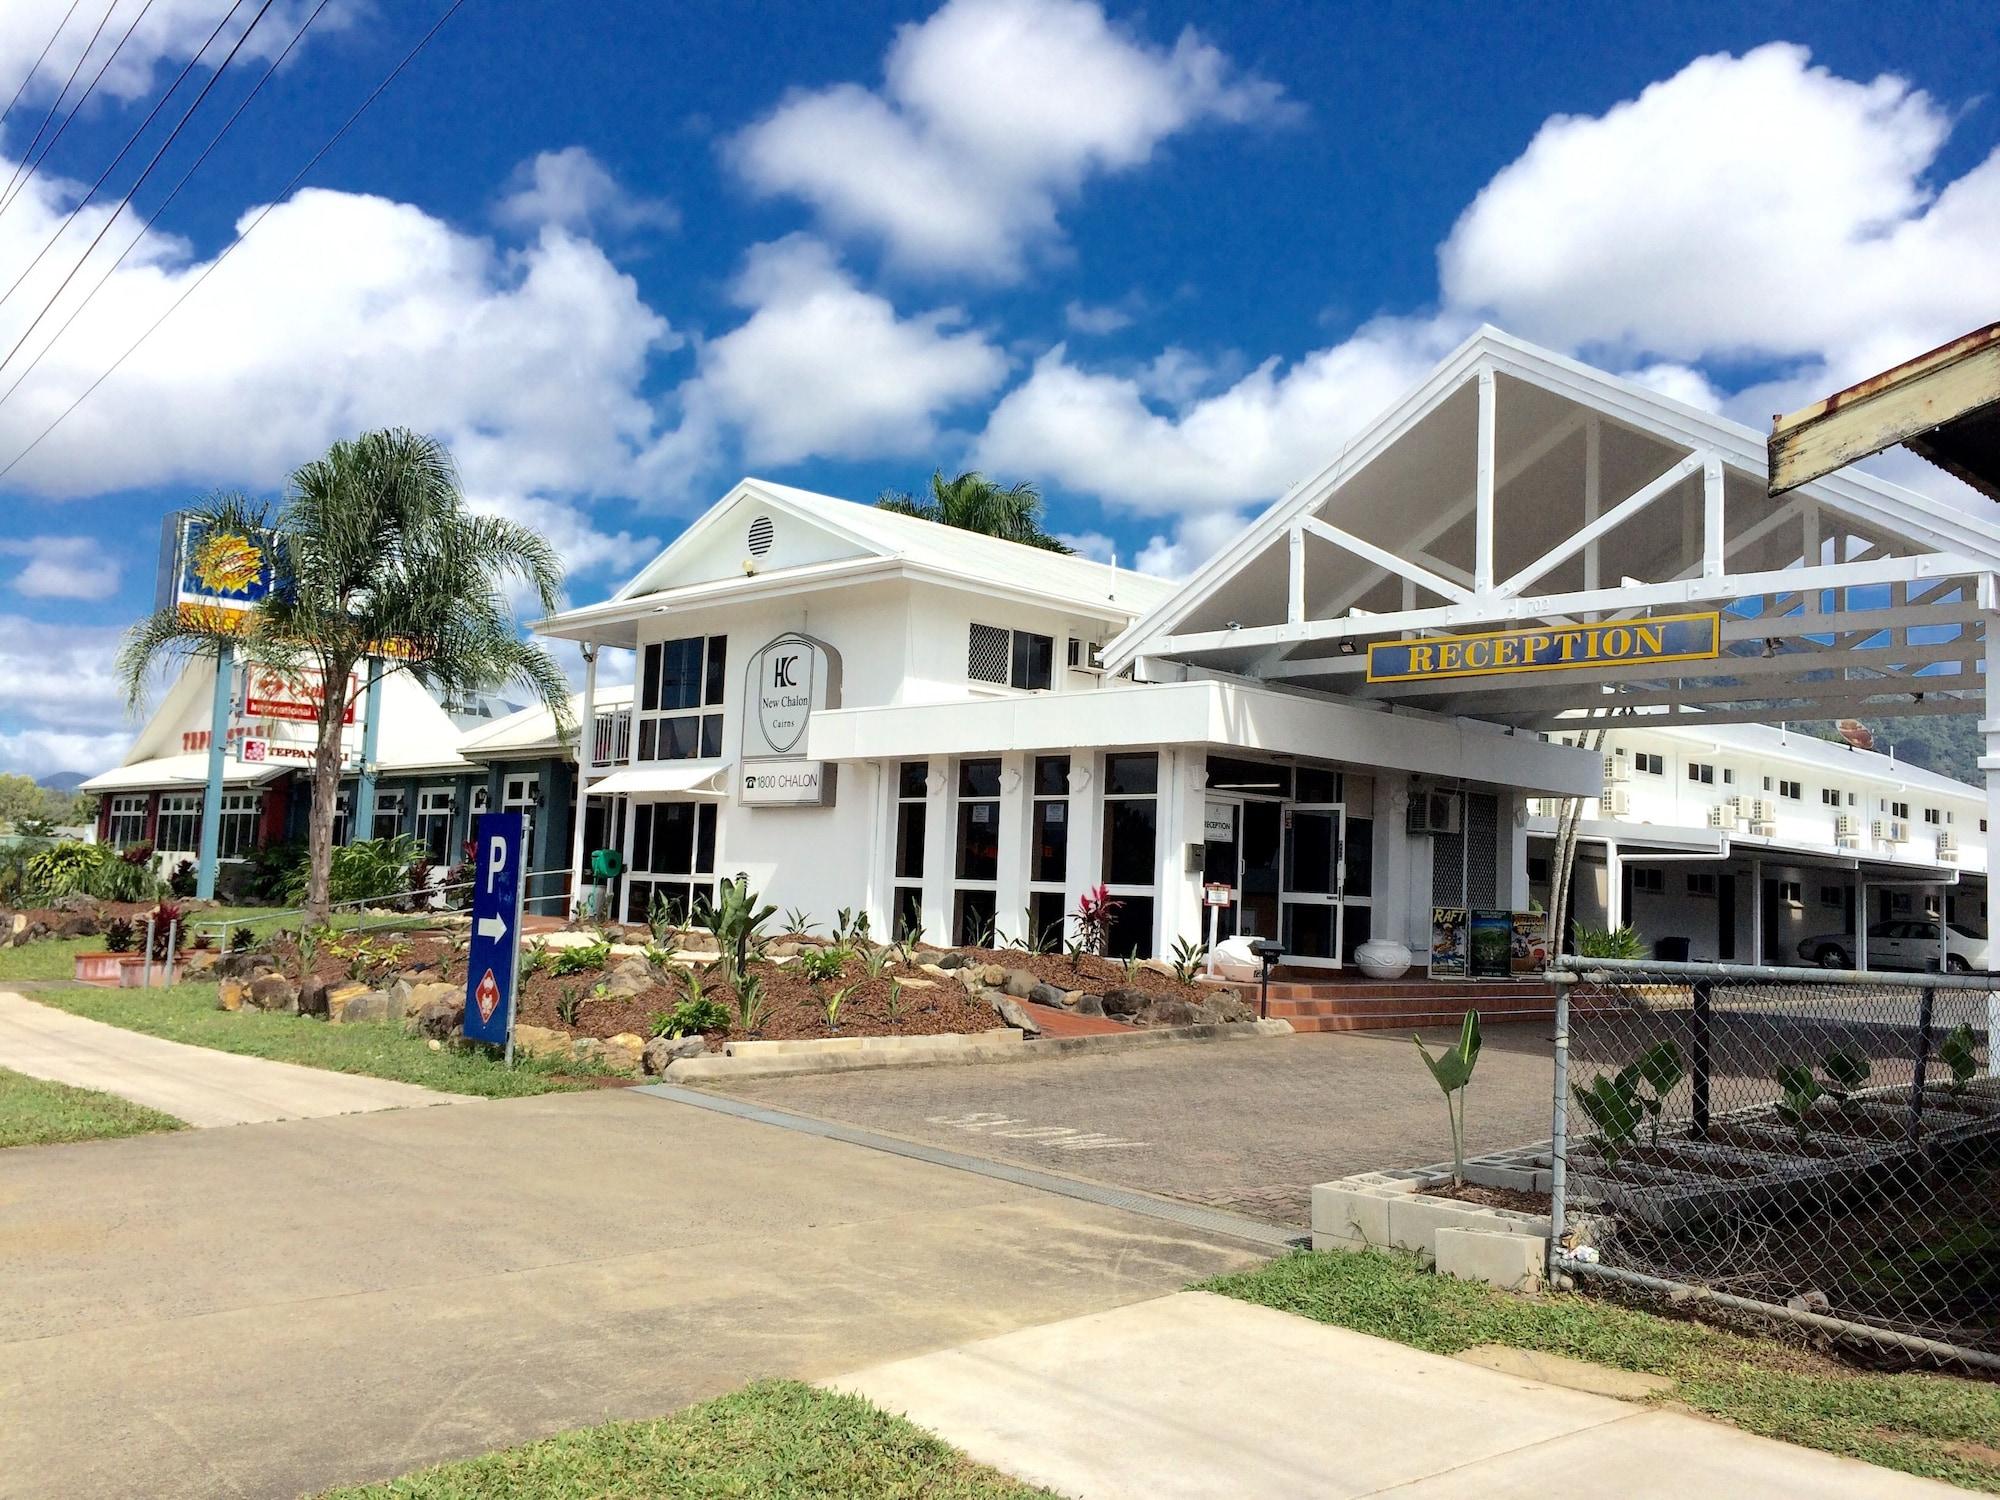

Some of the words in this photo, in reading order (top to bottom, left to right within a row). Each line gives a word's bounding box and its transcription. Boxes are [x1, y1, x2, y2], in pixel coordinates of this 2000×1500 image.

[1407, 625, 1666, 672] RECEPTION
[762, 697, 780, 709] New
[780, 695, 808, 708] Chalon
[772, 719, 795, 729] Cairns
[757, 775, 776, 789] 1800
[778, 774, 818, 788] CHALON
[487, 835, 508, 894] P
[1433, 908, 1467, 923] RAFT
